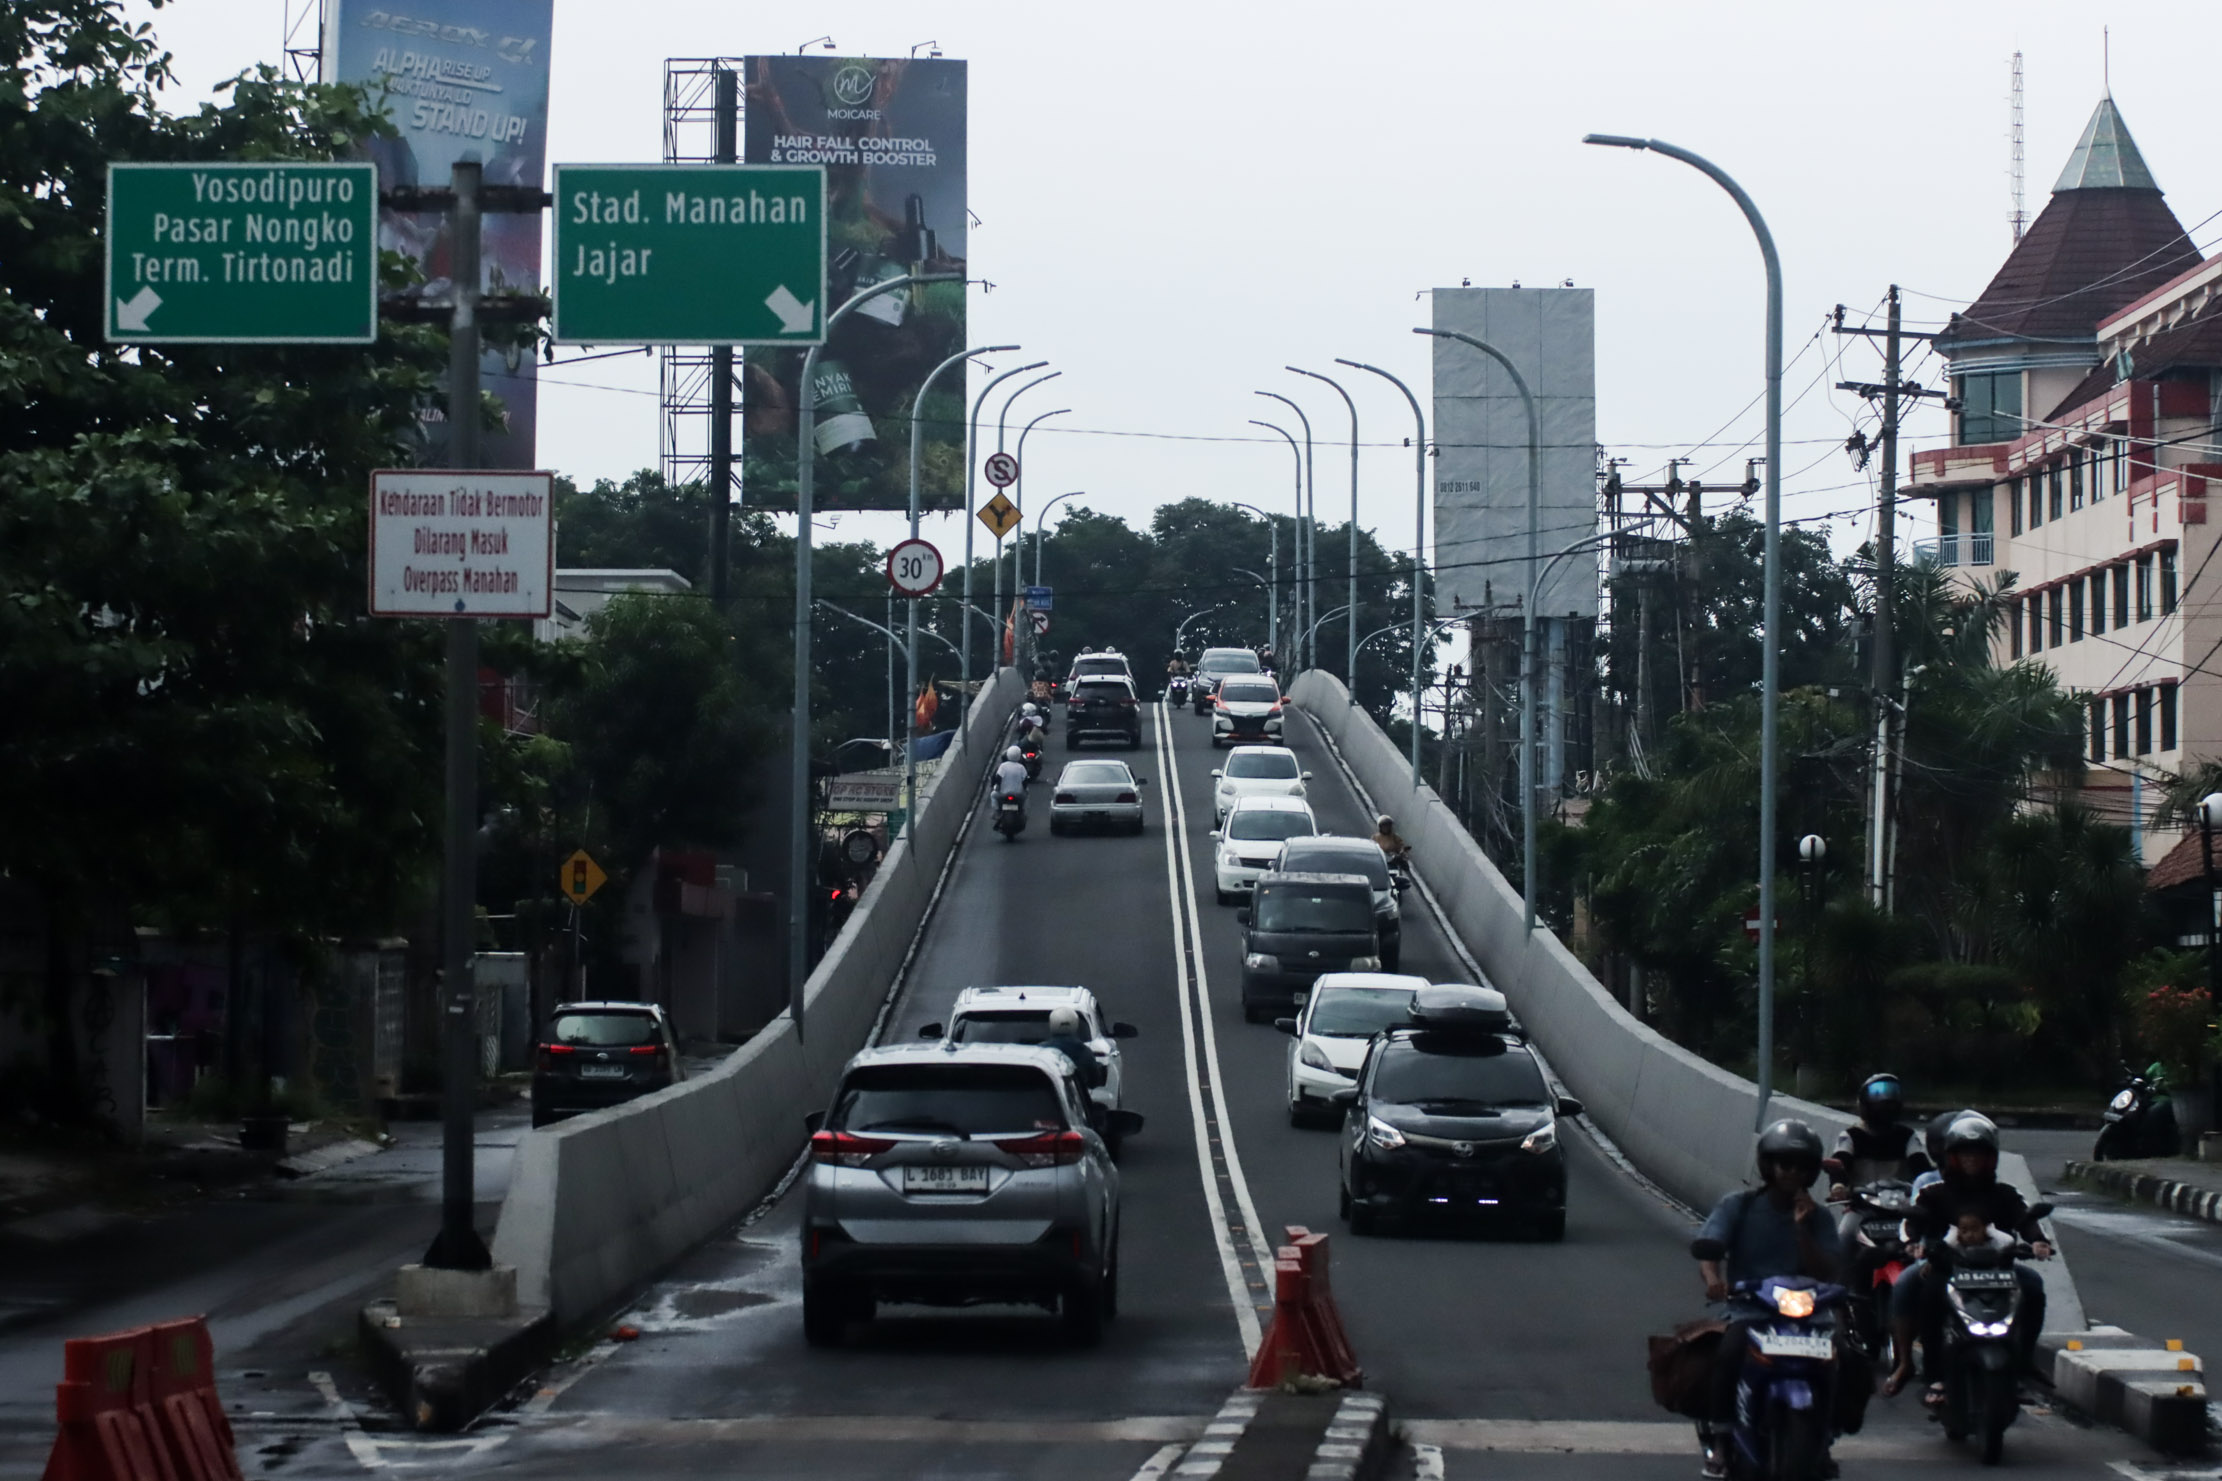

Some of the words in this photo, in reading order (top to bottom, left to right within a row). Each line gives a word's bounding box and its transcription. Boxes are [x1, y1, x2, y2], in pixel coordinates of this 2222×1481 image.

[372, 48, 443, 81] ALPHA
[442, 59, 473, 79] RISE
[474, 64, 491, 81] UP
[411, 101, 488, 138] STAND
[491, 110, 527, 145] UP!
[827, 109, 881, 121] MOICARE
[770, 149, 782, 162] &
[786, 150, 858, 164] GROWTH
[862, 152, 937, 166] BOOSTER
[774, 135, 812, 149] HAIR
[817, 136, 855, 150] FALL
[858, 137, 934, 152] CONTROL
[192, 171, 353, 211] Yosodipuro
[572, 190, 650, 224] Stad.
[665, 190, 806, 224] Manahan
[154, 213, 232, 243] Pasar
[246, 211, 353, 250] Nongko
[132, 252, 209, 283] Term.
[222, 250, 352, 283] Tirtonadi
[572, 240, 652, 285] Jajar
[380, 488, 445, 516] Kendaraan
[449, 487, 481, 517] Tidak
[486, 490, 543, 517] Bermotor
[414, 527, 466, 562] Dilarang
[471, 528, 508, 555] Masuk
[404, 566, 459, 598] Overpass
[464, 567, 518, 593] Manahan
[899, 557, 922, 579] 30
[922, 552, 934, 561] km
[907, 1168, 915, 1182] L
[960, 1167, 985, 1181] BAY
